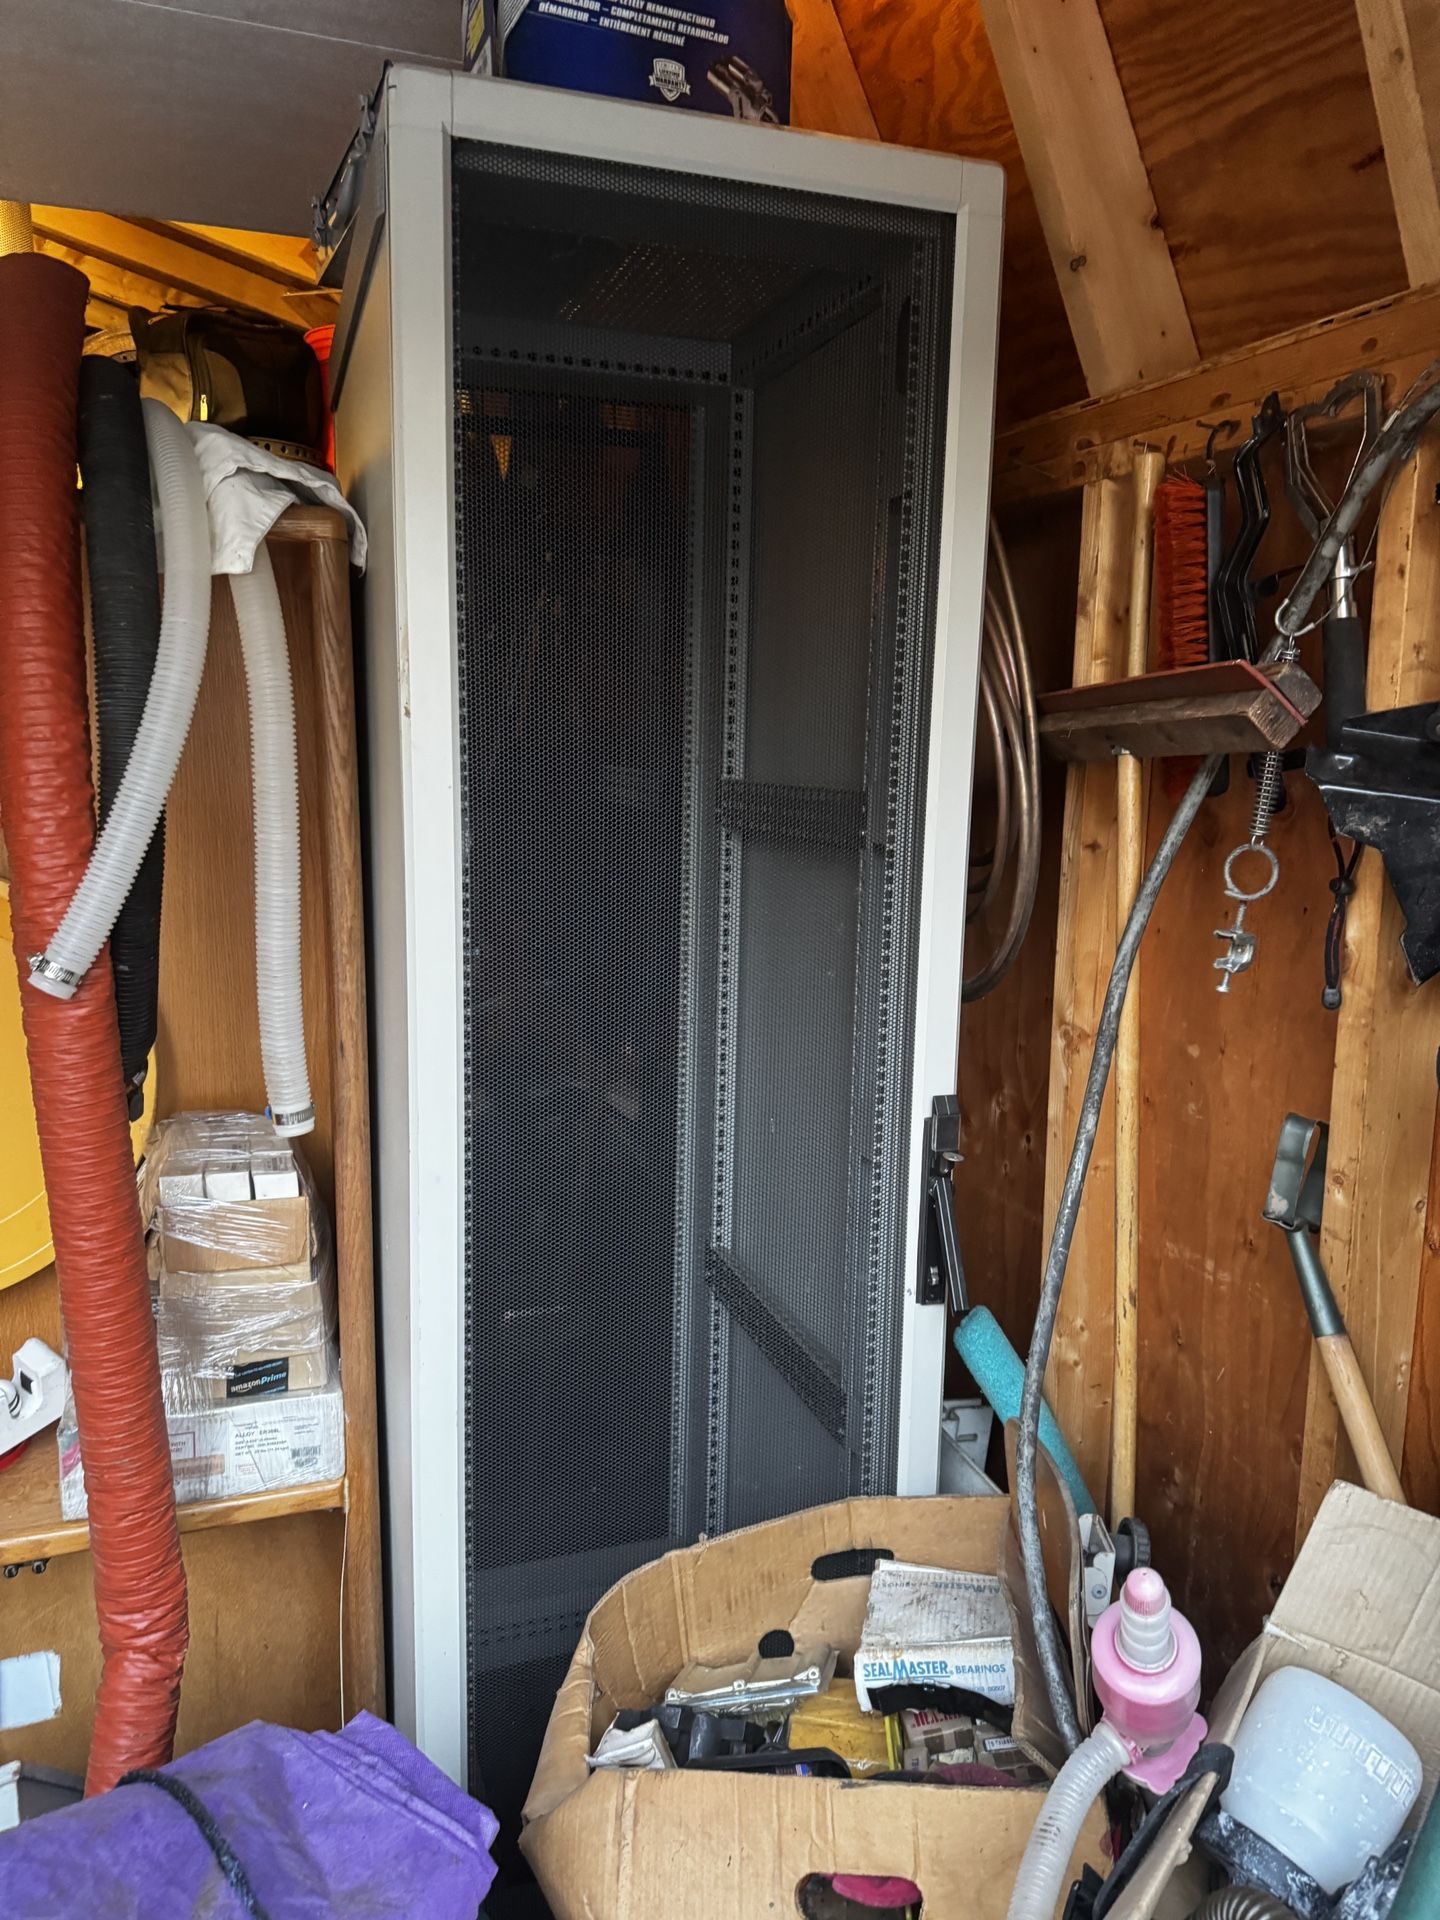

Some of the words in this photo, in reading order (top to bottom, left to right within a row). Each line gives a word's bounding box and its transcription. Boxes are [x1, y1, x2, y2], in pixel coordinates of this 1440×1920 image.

[538, 1, 589, 23] DÉMARREUR
[599, 16, 652, 38] ENTIÈREMENT
[611, 5, 676, 32] COMPLETAMENTE
[677, 21, 730, 45] REFABRICADO
[646, 1, 716, 28] REMANUFACTURED
[863, 1659, 949, 1681] SEALMASTER
[955, 1663, 1006, 1674] BEARINGS
